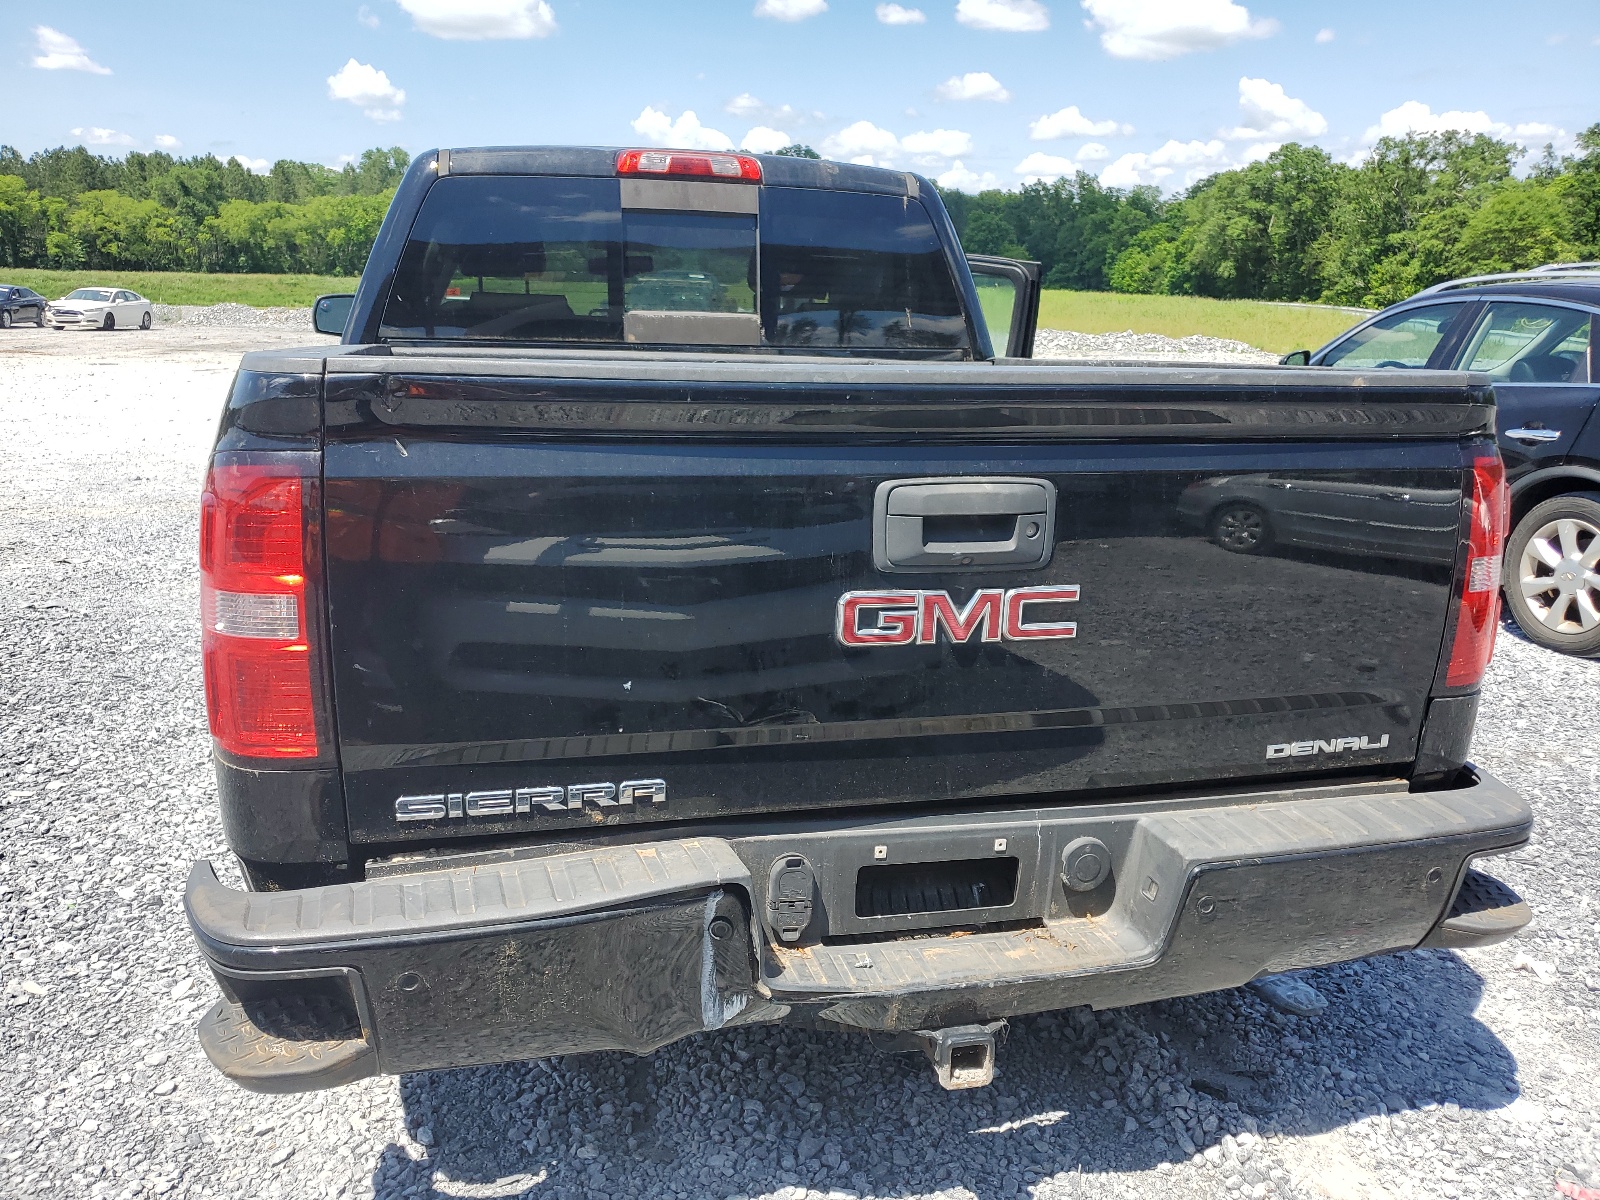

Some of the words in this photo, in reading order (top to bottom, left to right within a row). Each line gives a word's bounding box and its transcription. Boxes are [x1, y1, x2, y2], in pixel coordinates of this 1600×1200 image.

[836, 584, 1081, 647] GMC
[1265, 733, 1390, 760] DENALI
[395, 778, 667, 822] SIERRA
